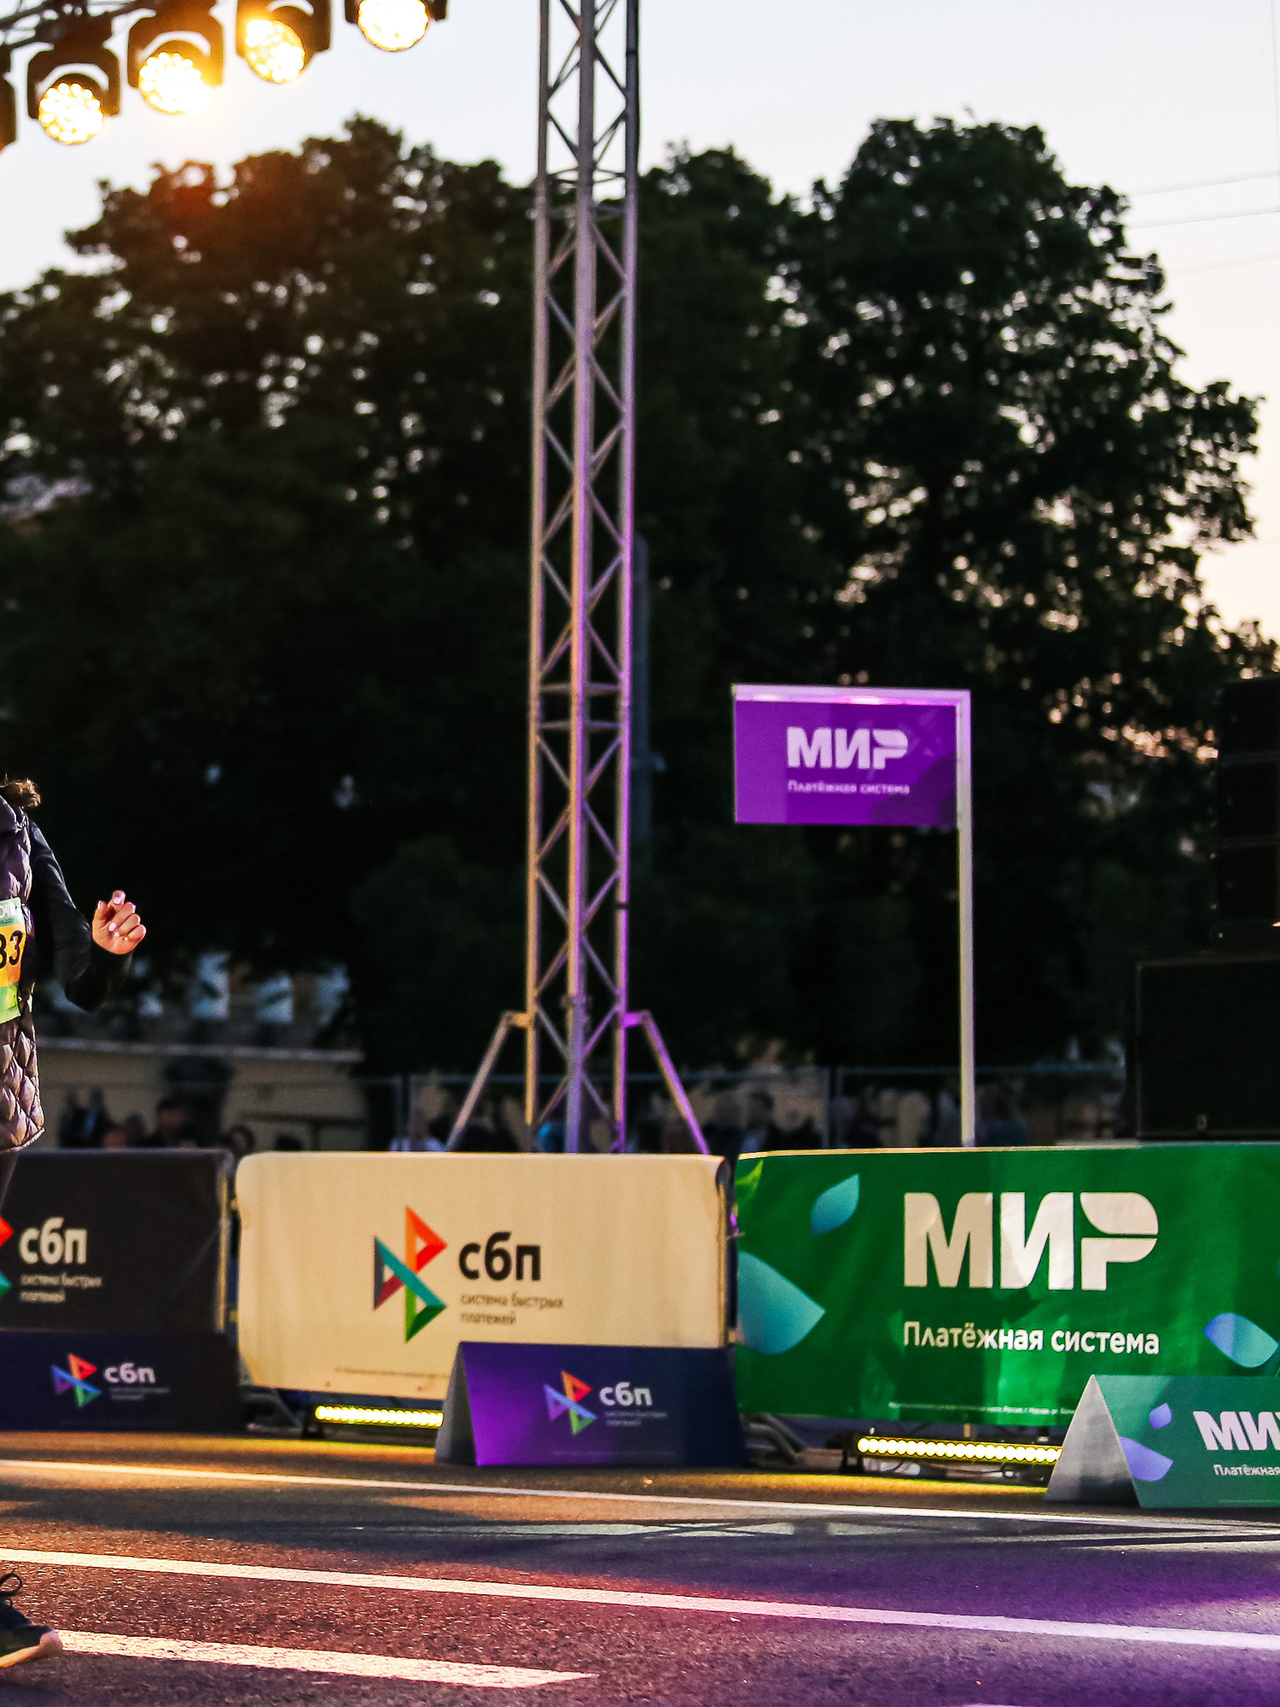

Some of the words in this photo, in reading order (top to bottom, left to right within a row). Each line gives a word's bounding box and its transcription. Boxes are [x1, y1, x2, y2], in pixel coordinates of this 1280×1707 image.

[787, 726, 908, 770] МИР
[860, 783, 910, 795] система
[19, 1216, 88, 1265] сбп
[459, 1231, 542, 1282] сбп
[904, 1192, 1159, 1291] МИР
[904, 1321, 1044, 1351] Платёжная
[1051, 1330, 1159, 1355] система
[104, 1362, 156, 1384] сбп
[599, 1381, 653, 1407] сбп
[1193, 1411, 1280, 1451] МИ
